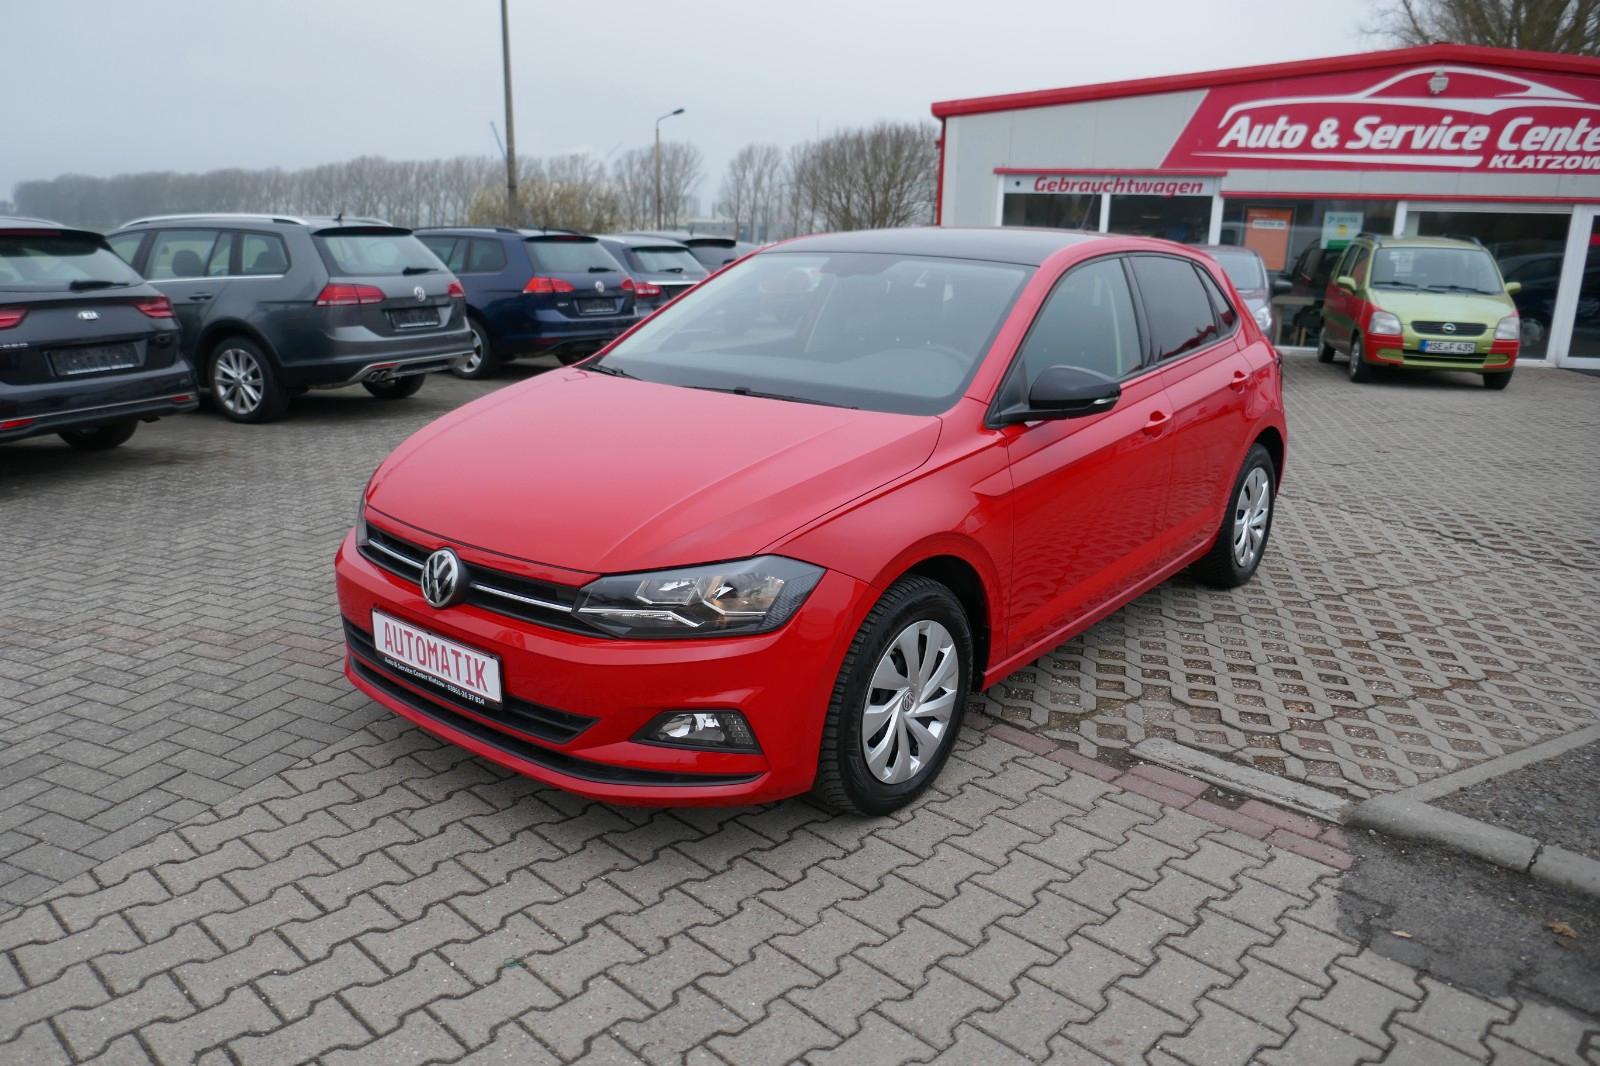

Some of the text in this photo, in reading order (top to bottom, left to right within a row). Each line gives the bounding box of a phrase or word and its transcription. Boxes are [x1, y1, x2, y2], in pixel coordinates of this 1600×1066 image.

[1216, 115, 1308, 148] Auto
[1311, 117, 1339, 149] &
[1344, 115, 1490, 150] Service
[1034, 176, 1204, 197] Gebrauchtwagen
[384, 621, 489, 693] AUTOMATIK
